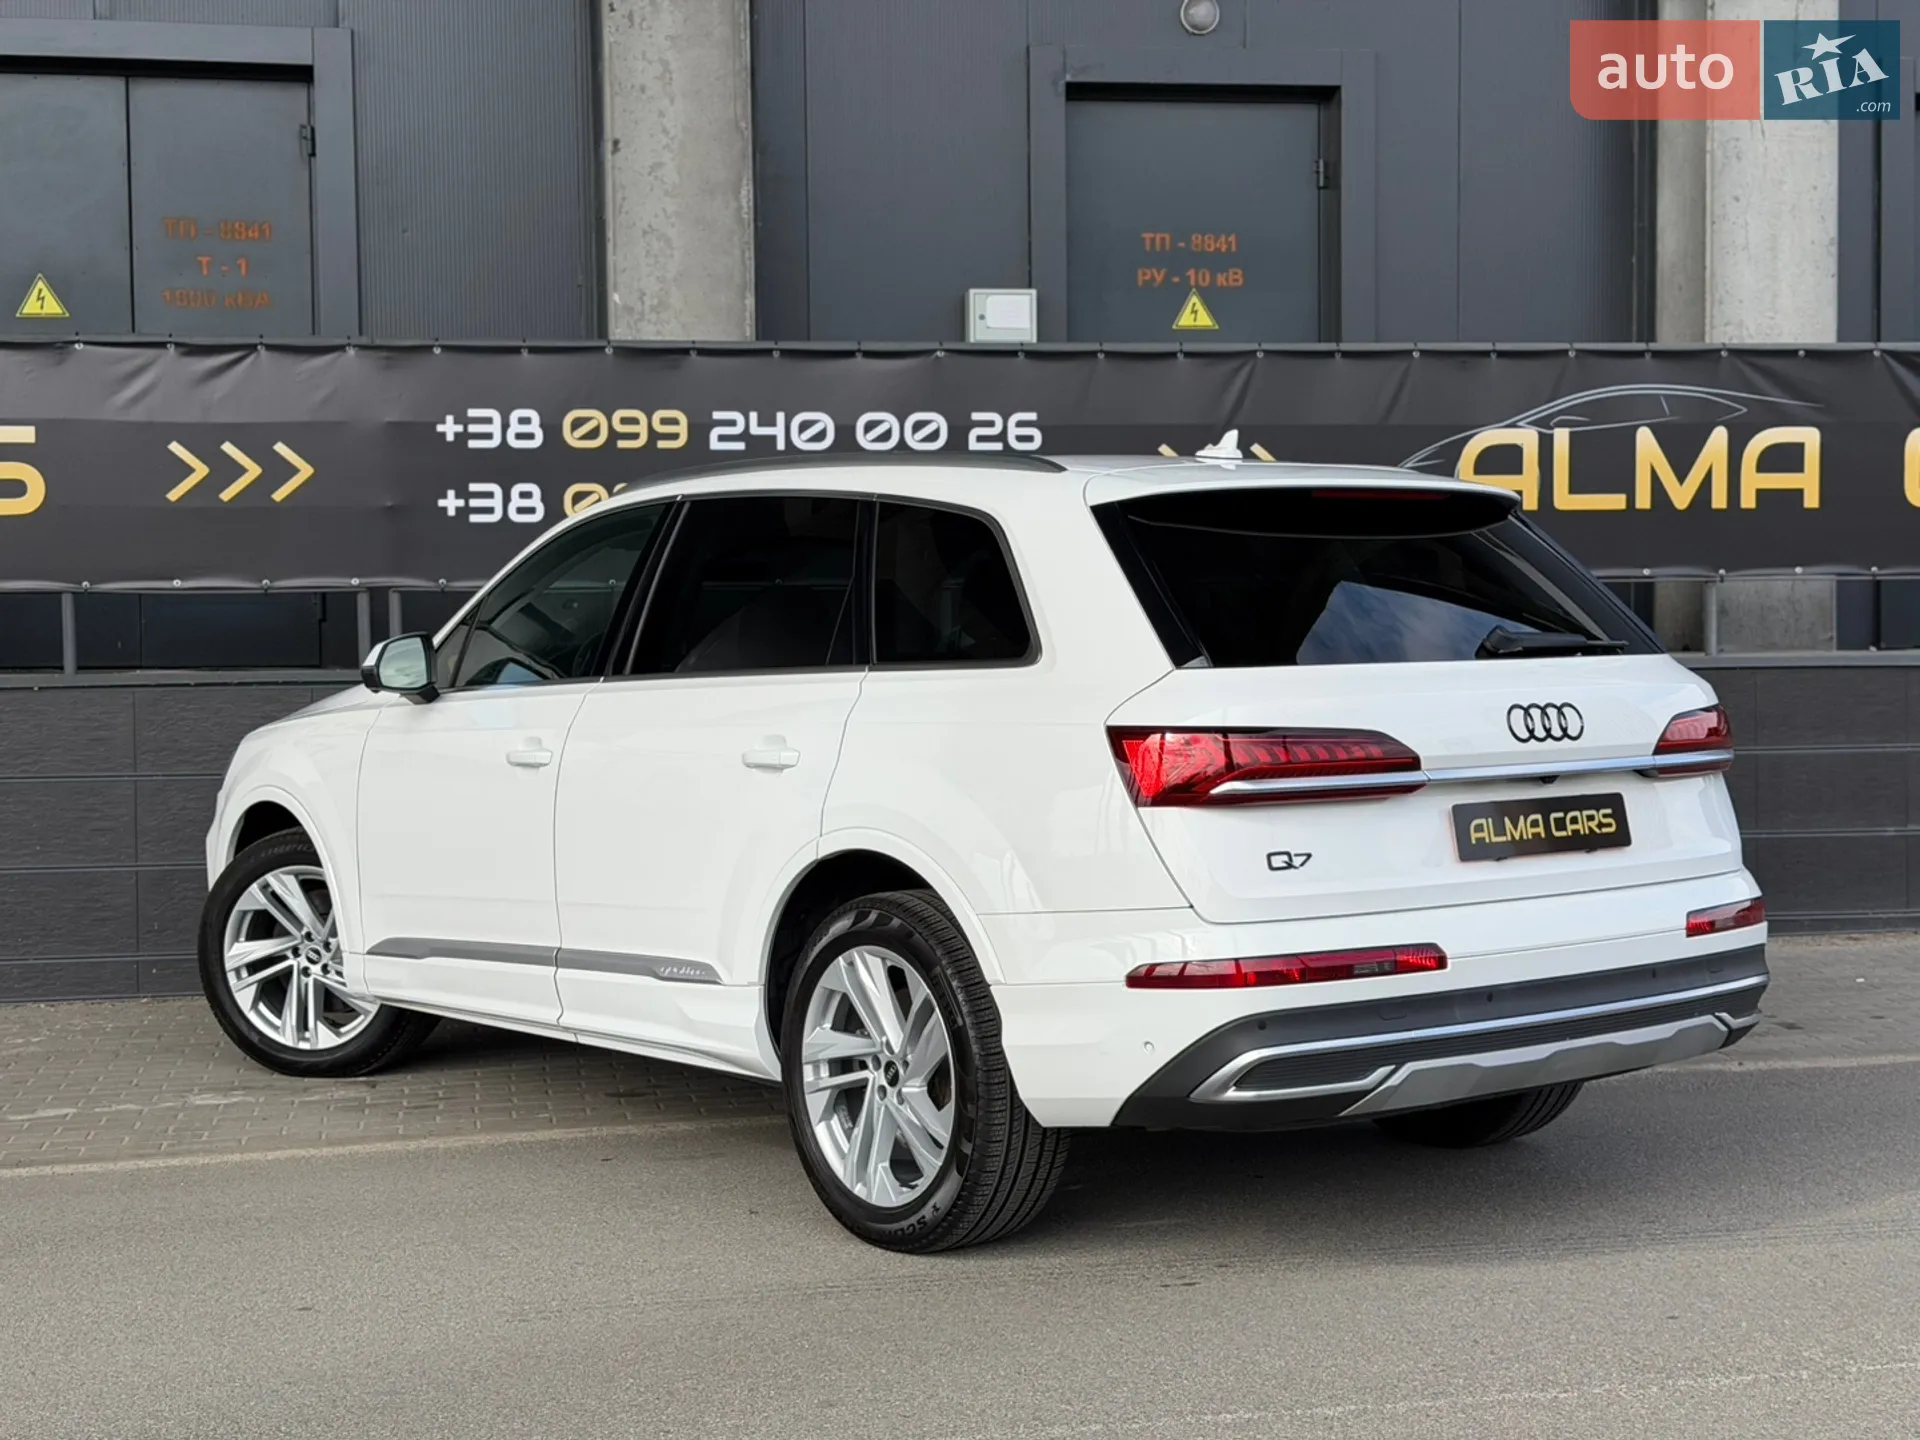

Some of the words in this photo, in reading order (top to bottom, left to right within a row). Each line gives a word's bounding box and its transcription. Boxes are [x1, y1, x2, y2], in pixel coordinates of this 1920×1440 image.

[1141, 233, 1172, 253] ТП
[1191, 233, 1238, 253] 8841
[236, 257, 248, 278] 1
[1137, 268, 1168, 288] РУ
[1185, 268, 1212, 288] 10
[1216, 268, 1245, 288] кВ
[435, 408, 544, 449] +38
[562, 408, 688, 449] 099
[709, 411, 835, 451] 240
[855, 411, 948, 451] 00
[968, 411, 1043, 451] 26
[1457, 425, 1821, 511] ALMA
[437, 482, 545, 523] +38
[1469, 813, 1546, 845] ALMA
[1549, 808, 1617, 838] CARS
[1266, 850, 1313, 871] Q7
